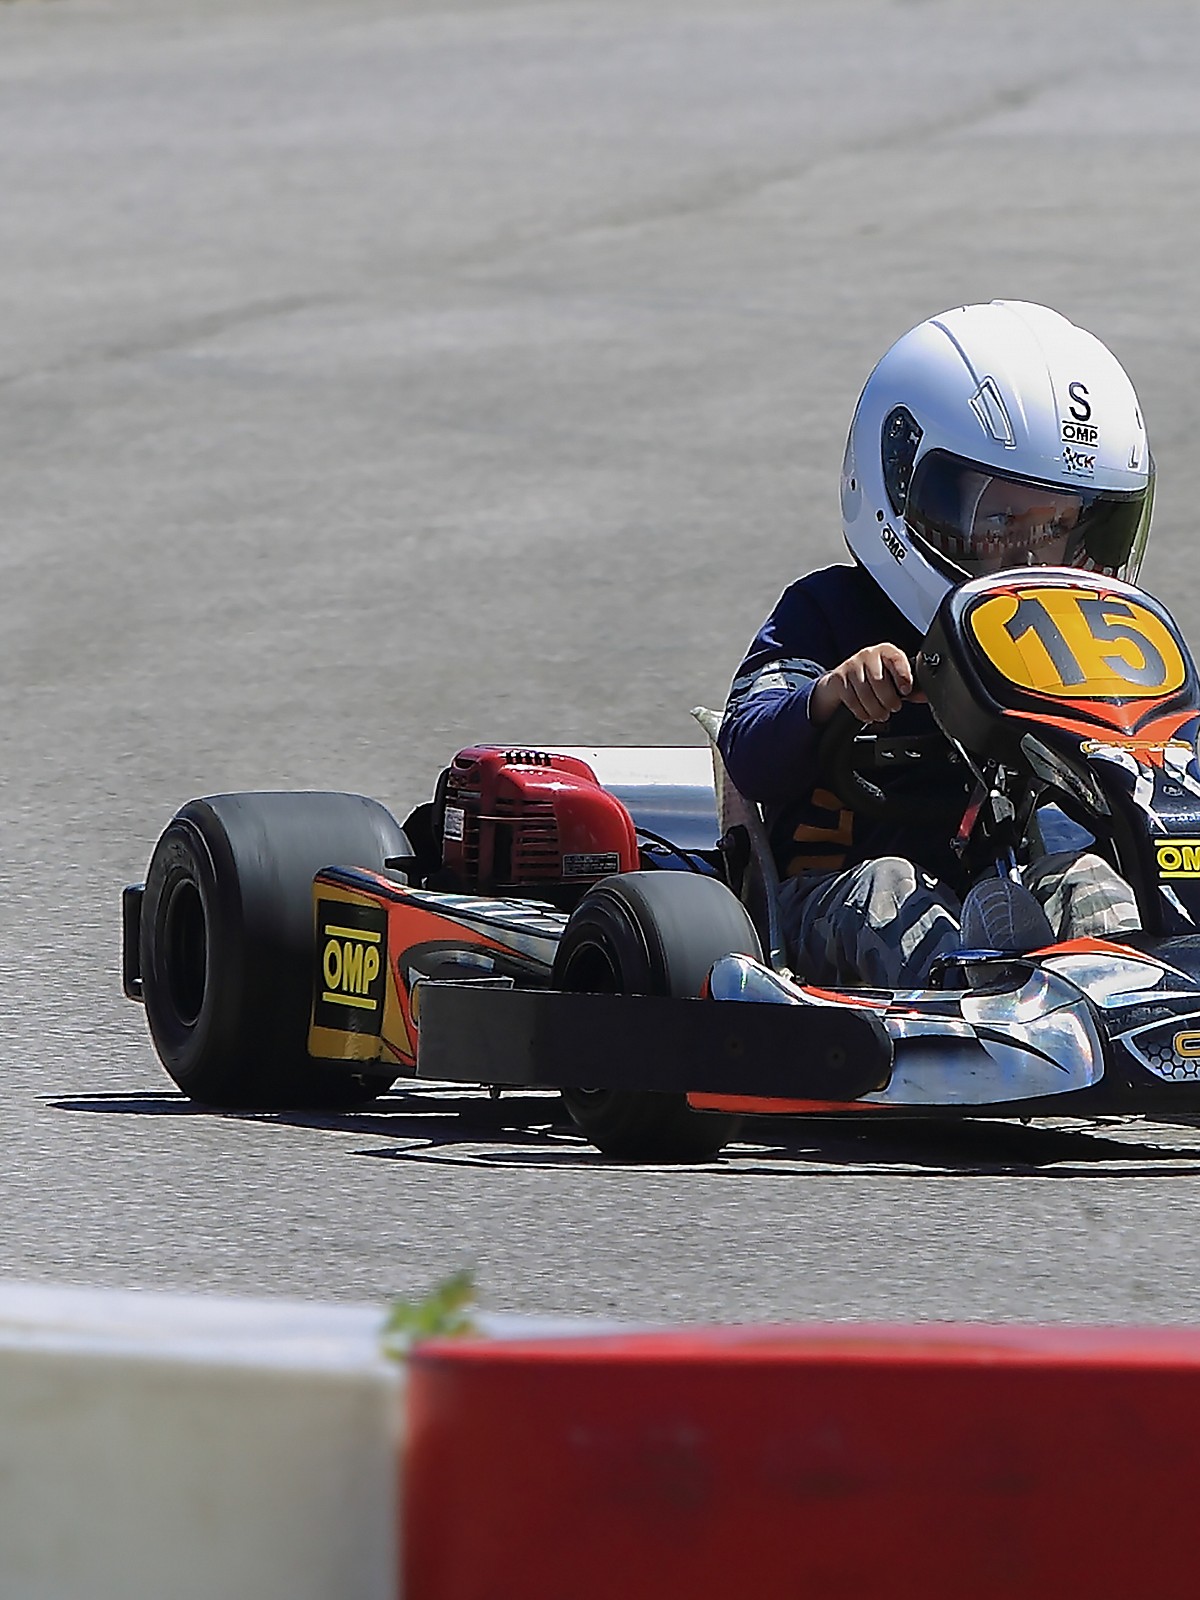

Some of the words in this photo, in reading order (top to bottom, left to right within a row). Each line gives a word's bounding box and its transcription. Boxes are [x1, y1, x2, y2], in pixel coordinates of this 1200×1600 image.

[1062, 425, 1098, 442] OMP
[882, 528, 906, 560] OMP
[1002, 598, 1167, 687] 15
[323, 939, 380, 995] OMP
